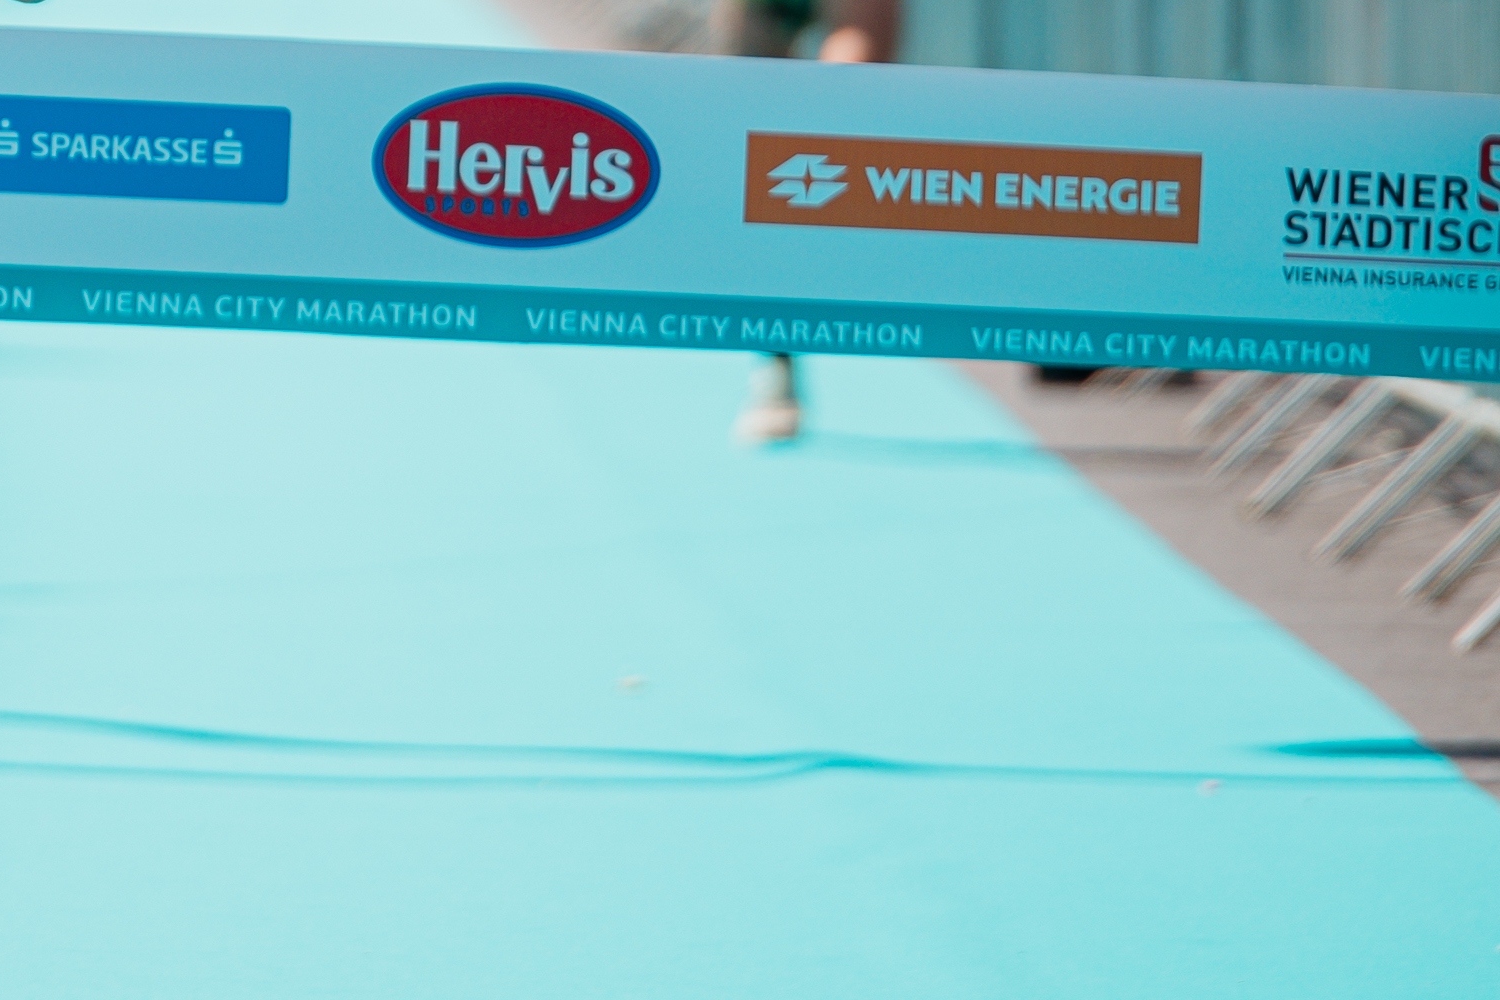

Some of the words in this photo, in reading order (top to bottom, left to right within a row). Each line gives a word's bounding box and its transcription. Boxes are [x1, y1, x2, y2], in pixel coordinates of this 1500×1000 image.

[32, 132, 207, 164] SPARKASSE
[405, 118, 635, 215] Hervis
[424, 194, 531, 218] SPORTS
[864, 166, 982, 207] WIEN
[994, 172, 1179, 215] ENERGIE
[1285, 166, 1469, 212] WIENER
[1283, 209, 1500, 253] STÄDTISC
[1282, 265, 1358, 287] VIENNA
[1363, 267, 1479, 291] INSURANCE
[83, 290, 202, 315] VIENNA
[215, 296, 284, 318] CITY
[297, 300, 475, 327] MARATHON
[526, 309, 646, 334] VIENNA
[659, 315, 727, 337] CITY
[741, 319, 920, 346] MARATHON
[972, 328, 1093, 353] VIENNA
[1105, 333, 1175, 356] CITY
[1186, 336, 1371, 367] MARATHON
[1419, 345, 1500, 372] VIEN
